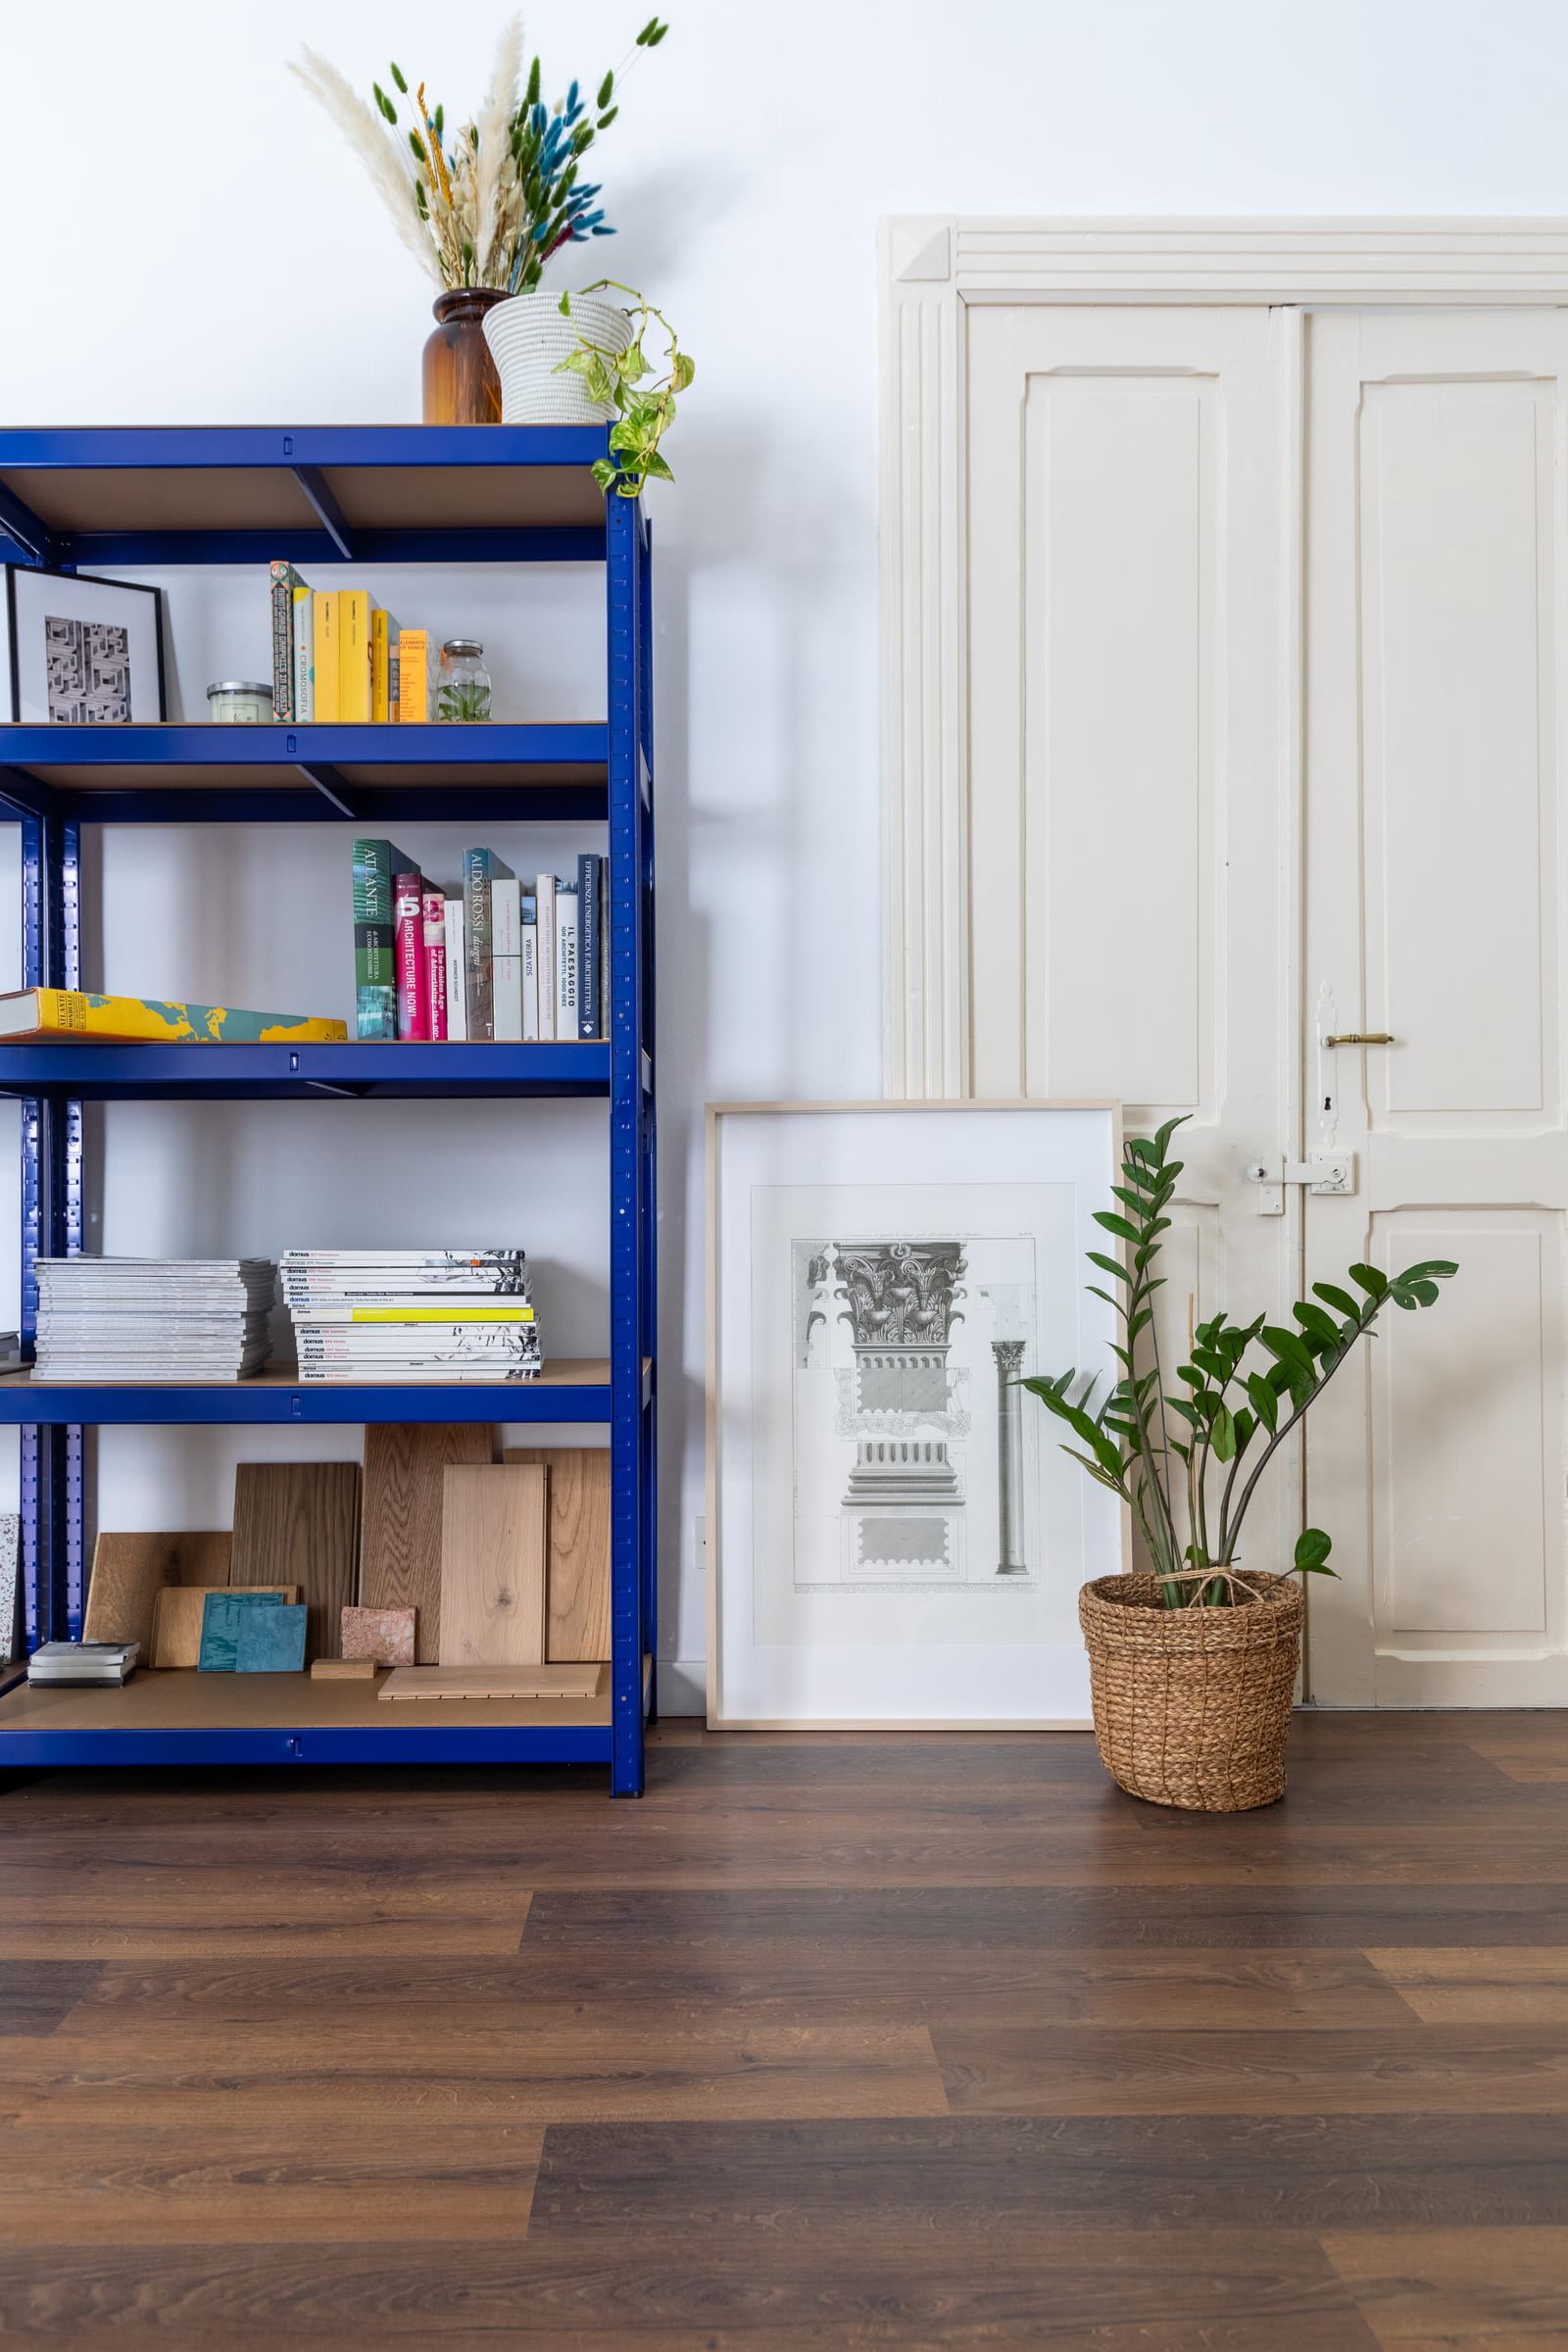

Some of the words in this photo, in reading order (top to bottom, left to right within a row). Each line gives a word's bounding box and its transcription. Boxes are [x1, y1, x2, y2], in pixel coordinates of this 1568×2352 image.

[299, 655, 308, 714] CROMOSOFIA
[364, 848, 378, 916] ATLANTE
[471, 855, 483, 891] ALDO
[472, 895, 484, 931] ROSSI
[567, 926, 575, 938] IL
[404, 919, 416, 990] ARCHITECTURE
[469, 936, 484, 966] disegni
[407, 992, 417, 1017] NOW!
[437, 994, 446, 1010] Age
